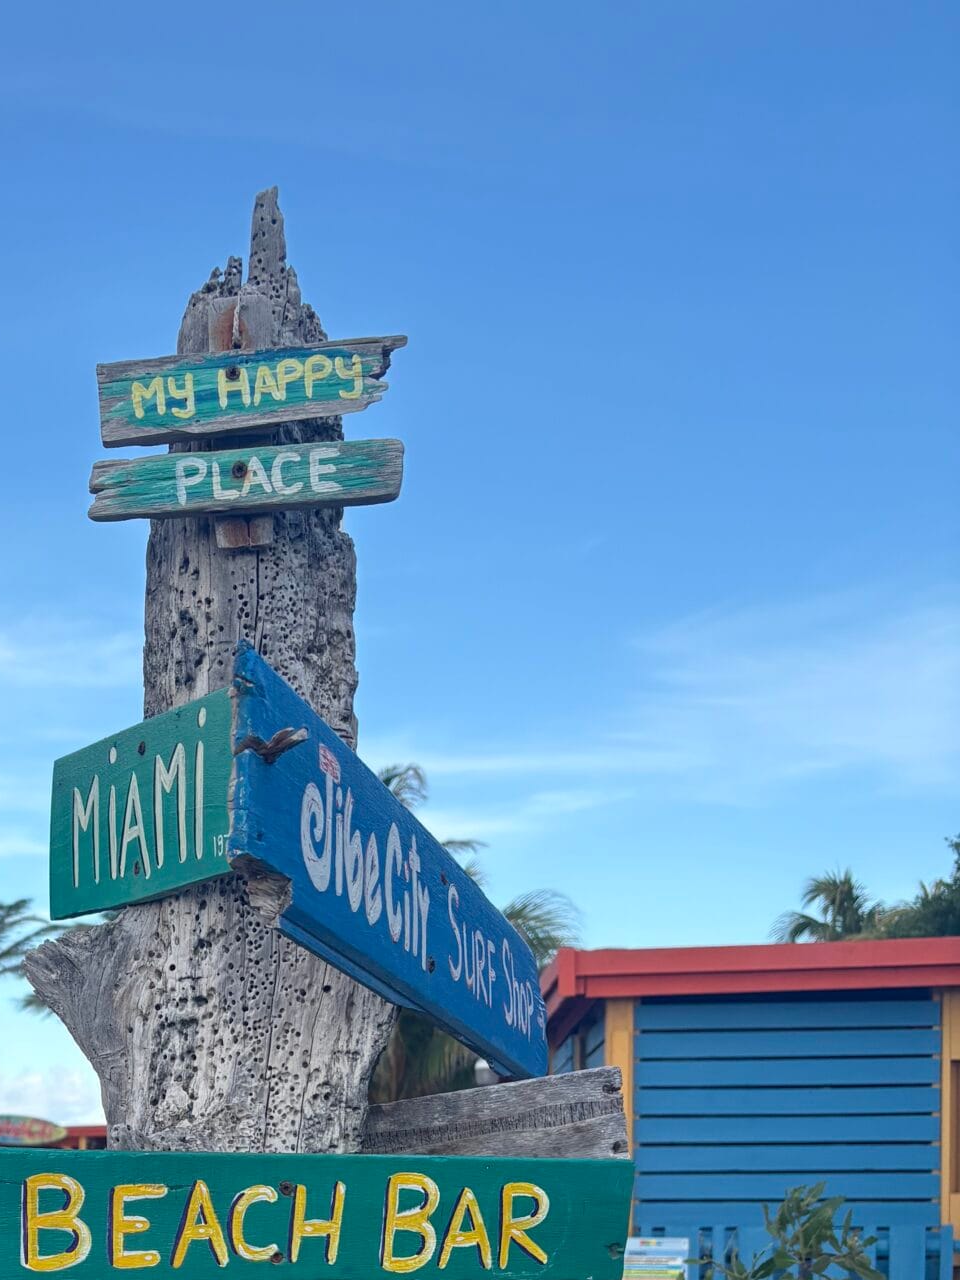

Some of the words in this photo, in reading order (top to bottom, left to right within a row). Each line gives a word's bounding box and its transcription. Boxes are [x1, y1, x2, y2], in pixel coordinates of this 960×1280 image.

[131, 372, 195, 419] MY
[217, 353, 363, 410] HAPPY
[175, 448, 343, 506] PLACE
[20, 1172, 346, 1271] BEACH
[380, 1171, 550, 1273] BAR
